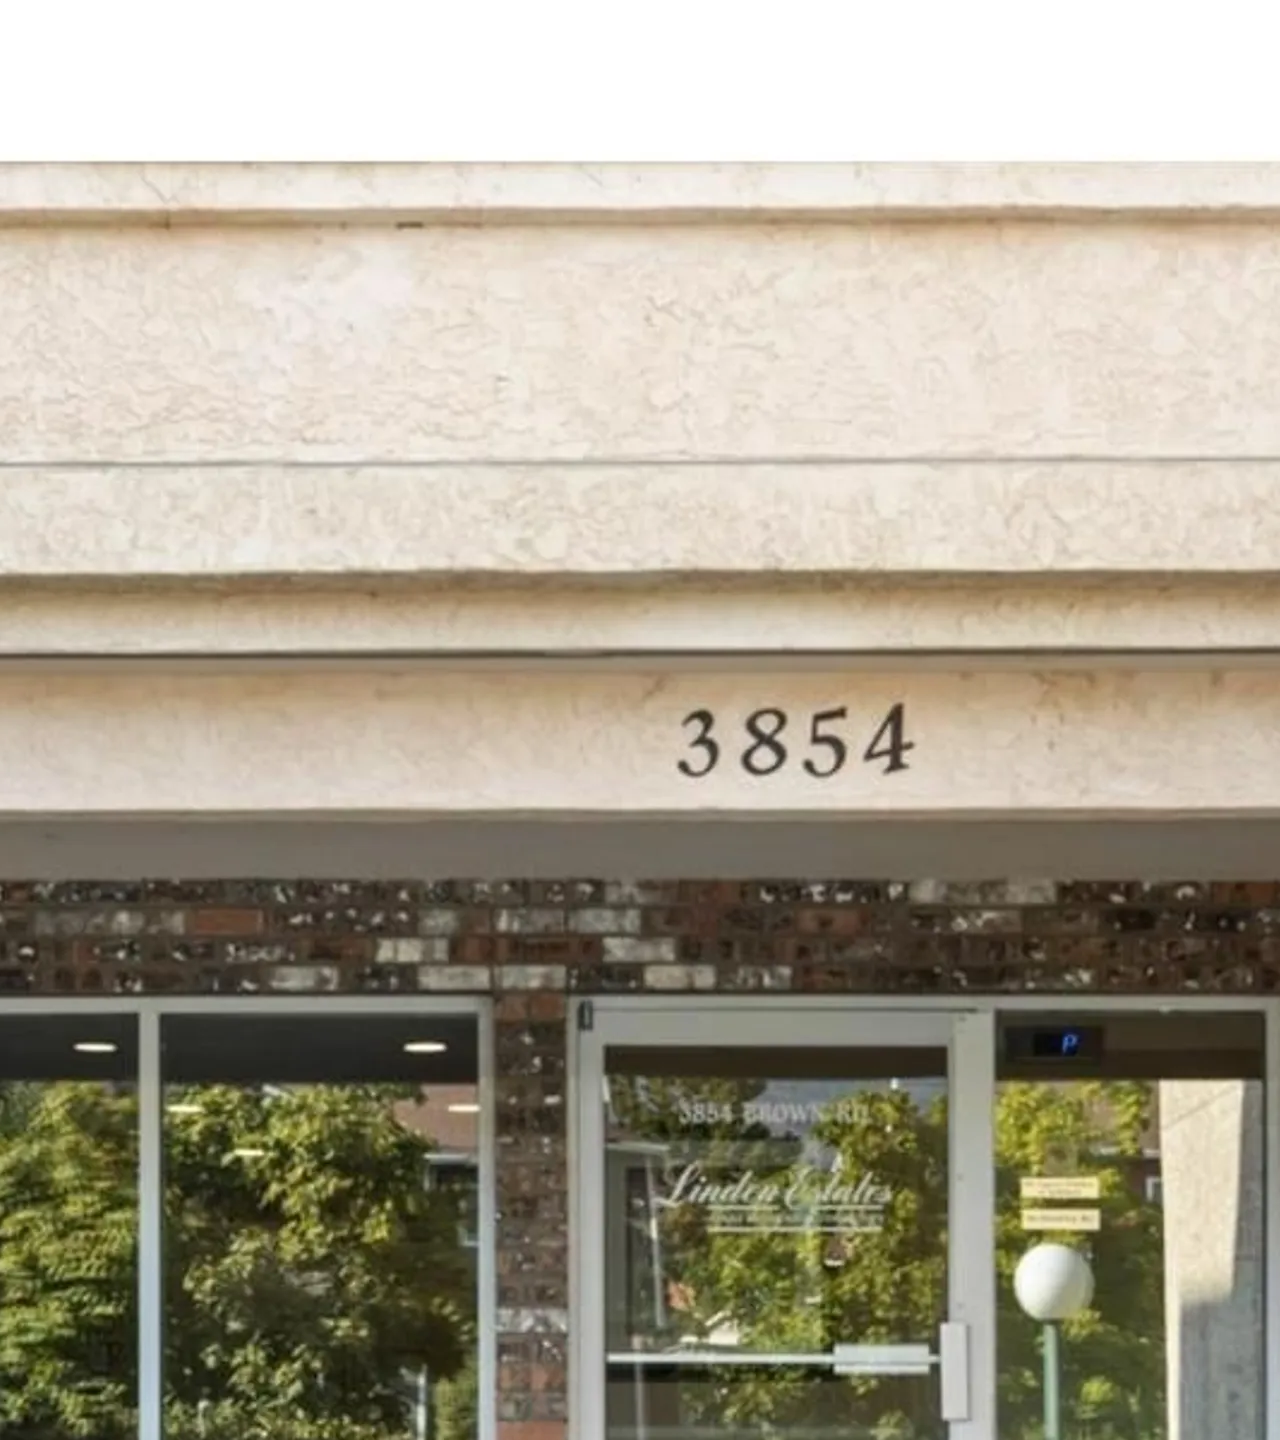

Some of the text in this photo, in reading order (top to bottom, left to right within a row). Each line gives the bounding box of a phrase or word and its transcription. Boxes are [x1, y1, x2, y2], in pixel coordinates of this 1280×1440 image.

[677, 701, 915, 778] 3854
[678, 1100, 733, 1124] 3854
[742, 1101, 826, 1124] BROWN
[657, 1160, 893, 1209] Linden Estates
